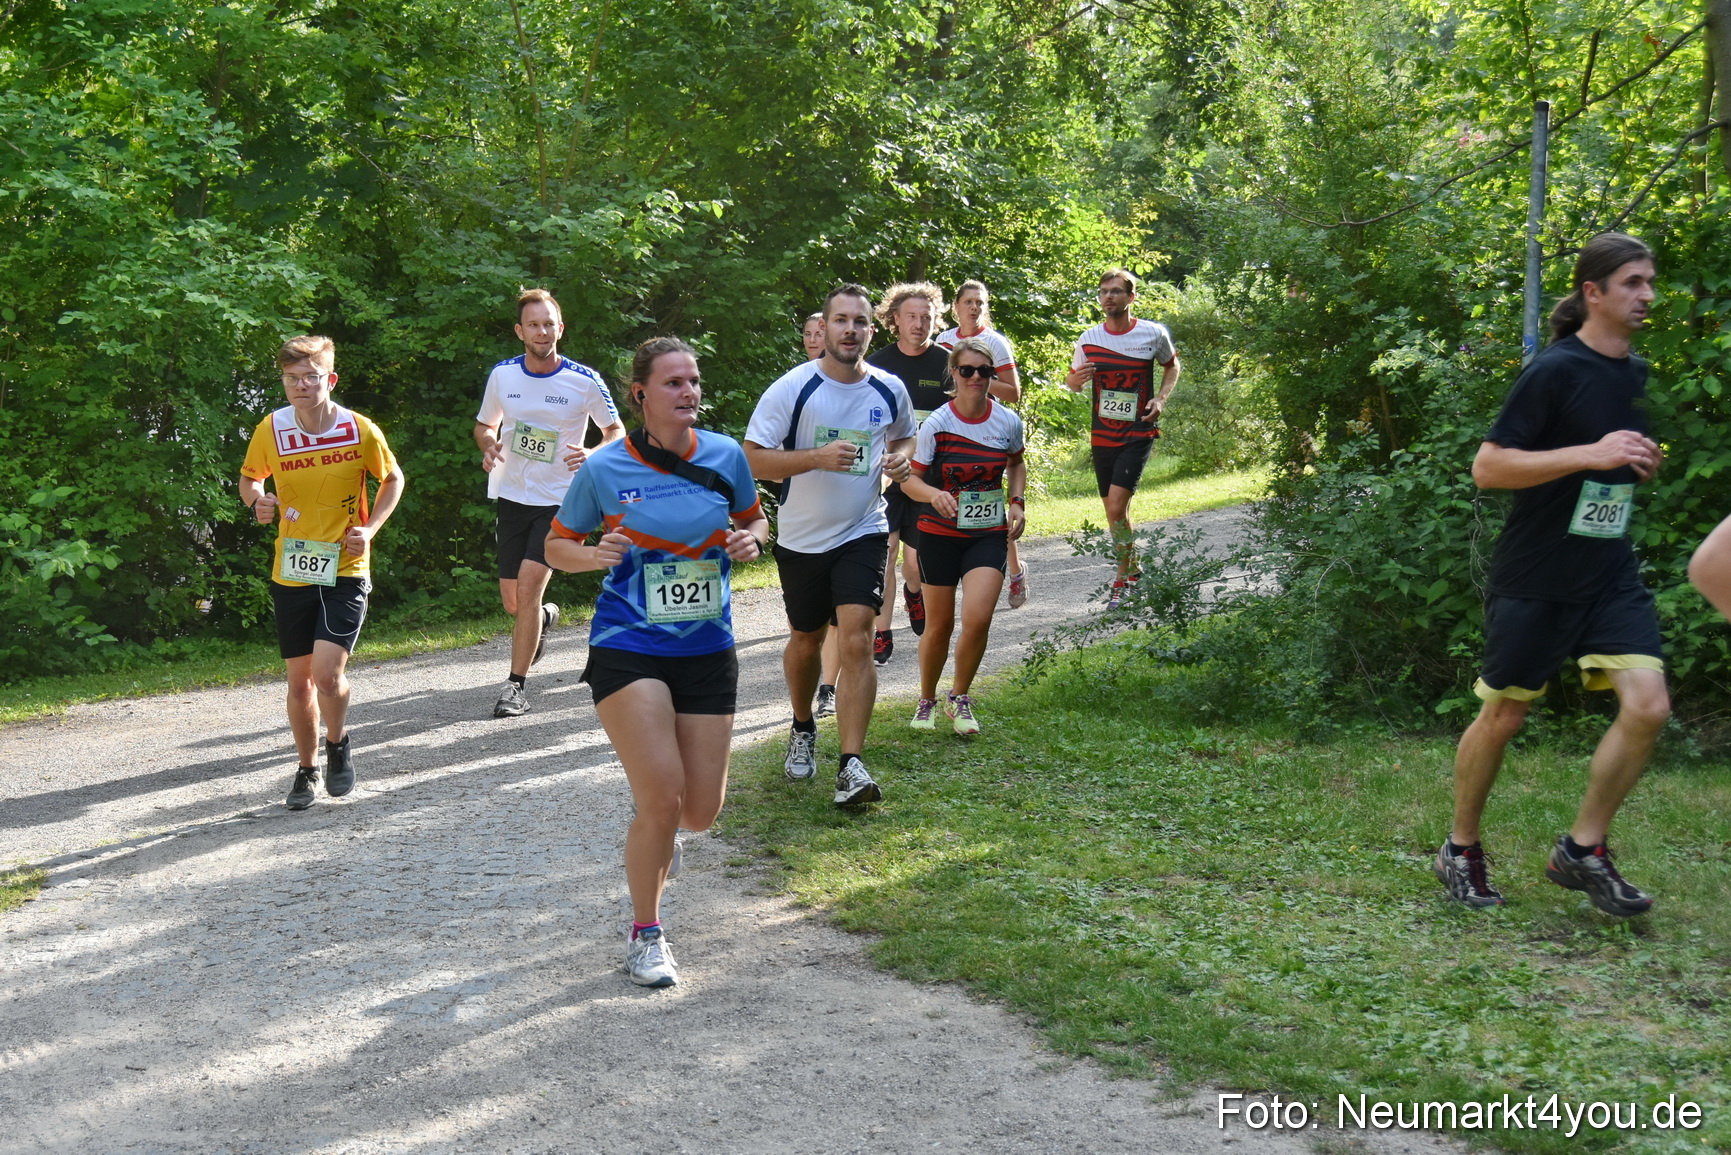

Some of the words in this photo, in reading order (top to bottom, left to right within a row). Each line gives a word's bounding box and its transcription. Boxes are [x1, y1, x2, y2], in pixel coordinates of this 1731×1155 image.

[1103, 400, 1132, 413] 2248
[520, 436, 546, 453] 936
[280, 457, 316, 471] MAX
[321, 450, 363, 465] BÖGL
[645, 489, 682, 500] Neumarkt
[964, 503, 998, 518] 2251
[1582, 502, 1625, 523] 2081
[289, 554, 331, 573] 1687
[656, 581, 711, 605] 1921
